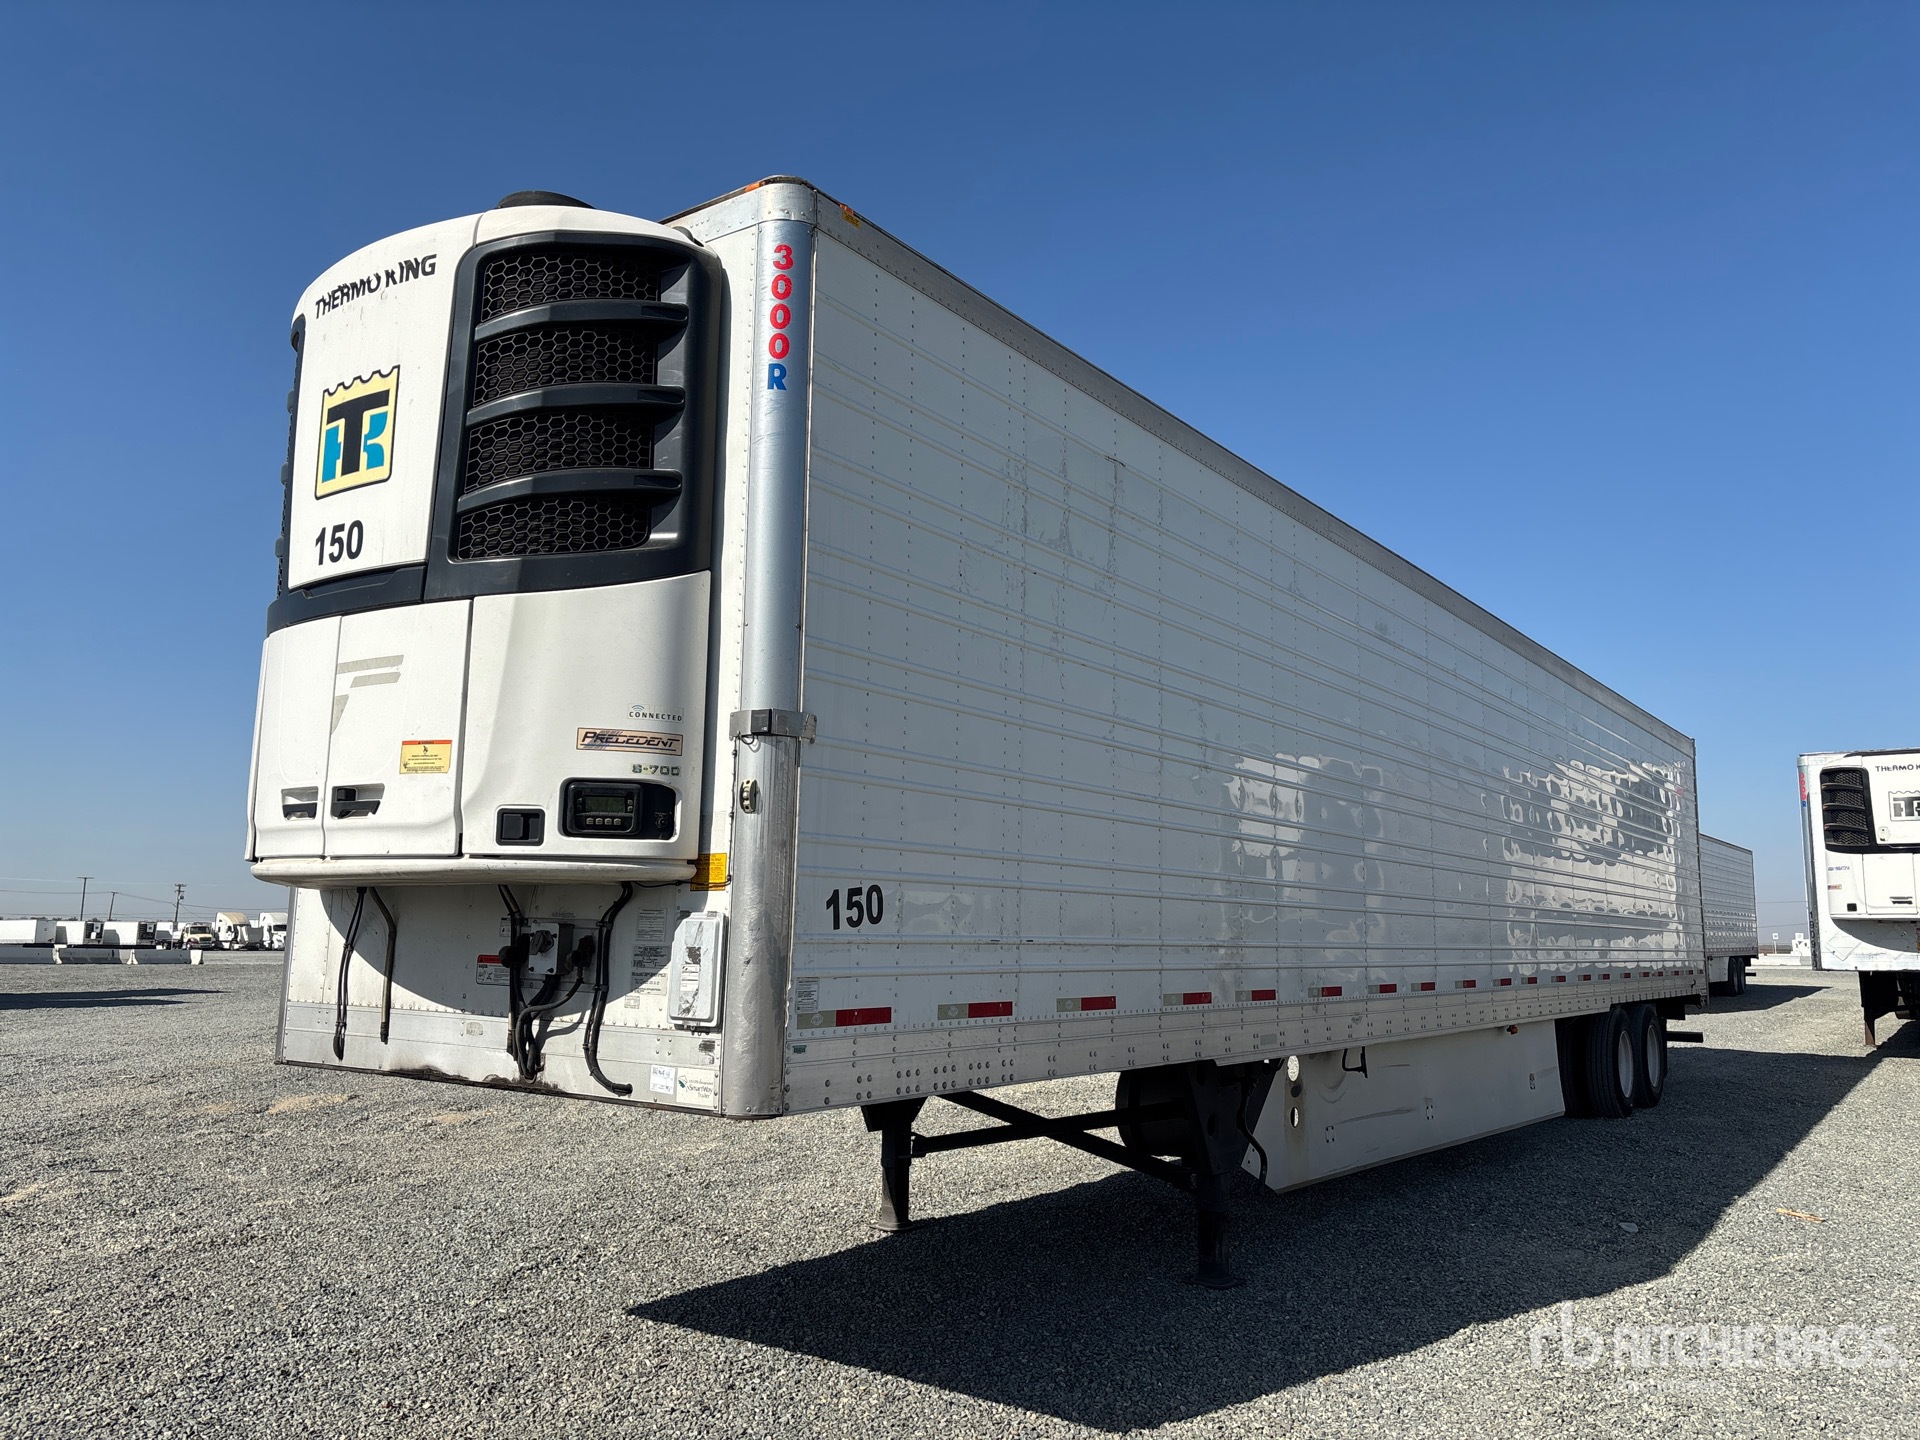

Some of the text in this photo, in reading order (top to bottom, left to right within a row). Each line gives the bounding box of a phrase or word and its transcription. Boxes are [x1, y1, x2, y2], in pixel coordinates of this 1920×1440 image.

[315, 253, 438, 320] THERMO KING
[767, 243, 795, 391] 3000R
[315, 519, 364, 566] 150
[628, 711, 683, 721] CONNECTED
[581, 731, 681, 748] PRECEDENT
[1875, 763, 1914, 773] THERMO
[825, 884, 884, 930] 150
